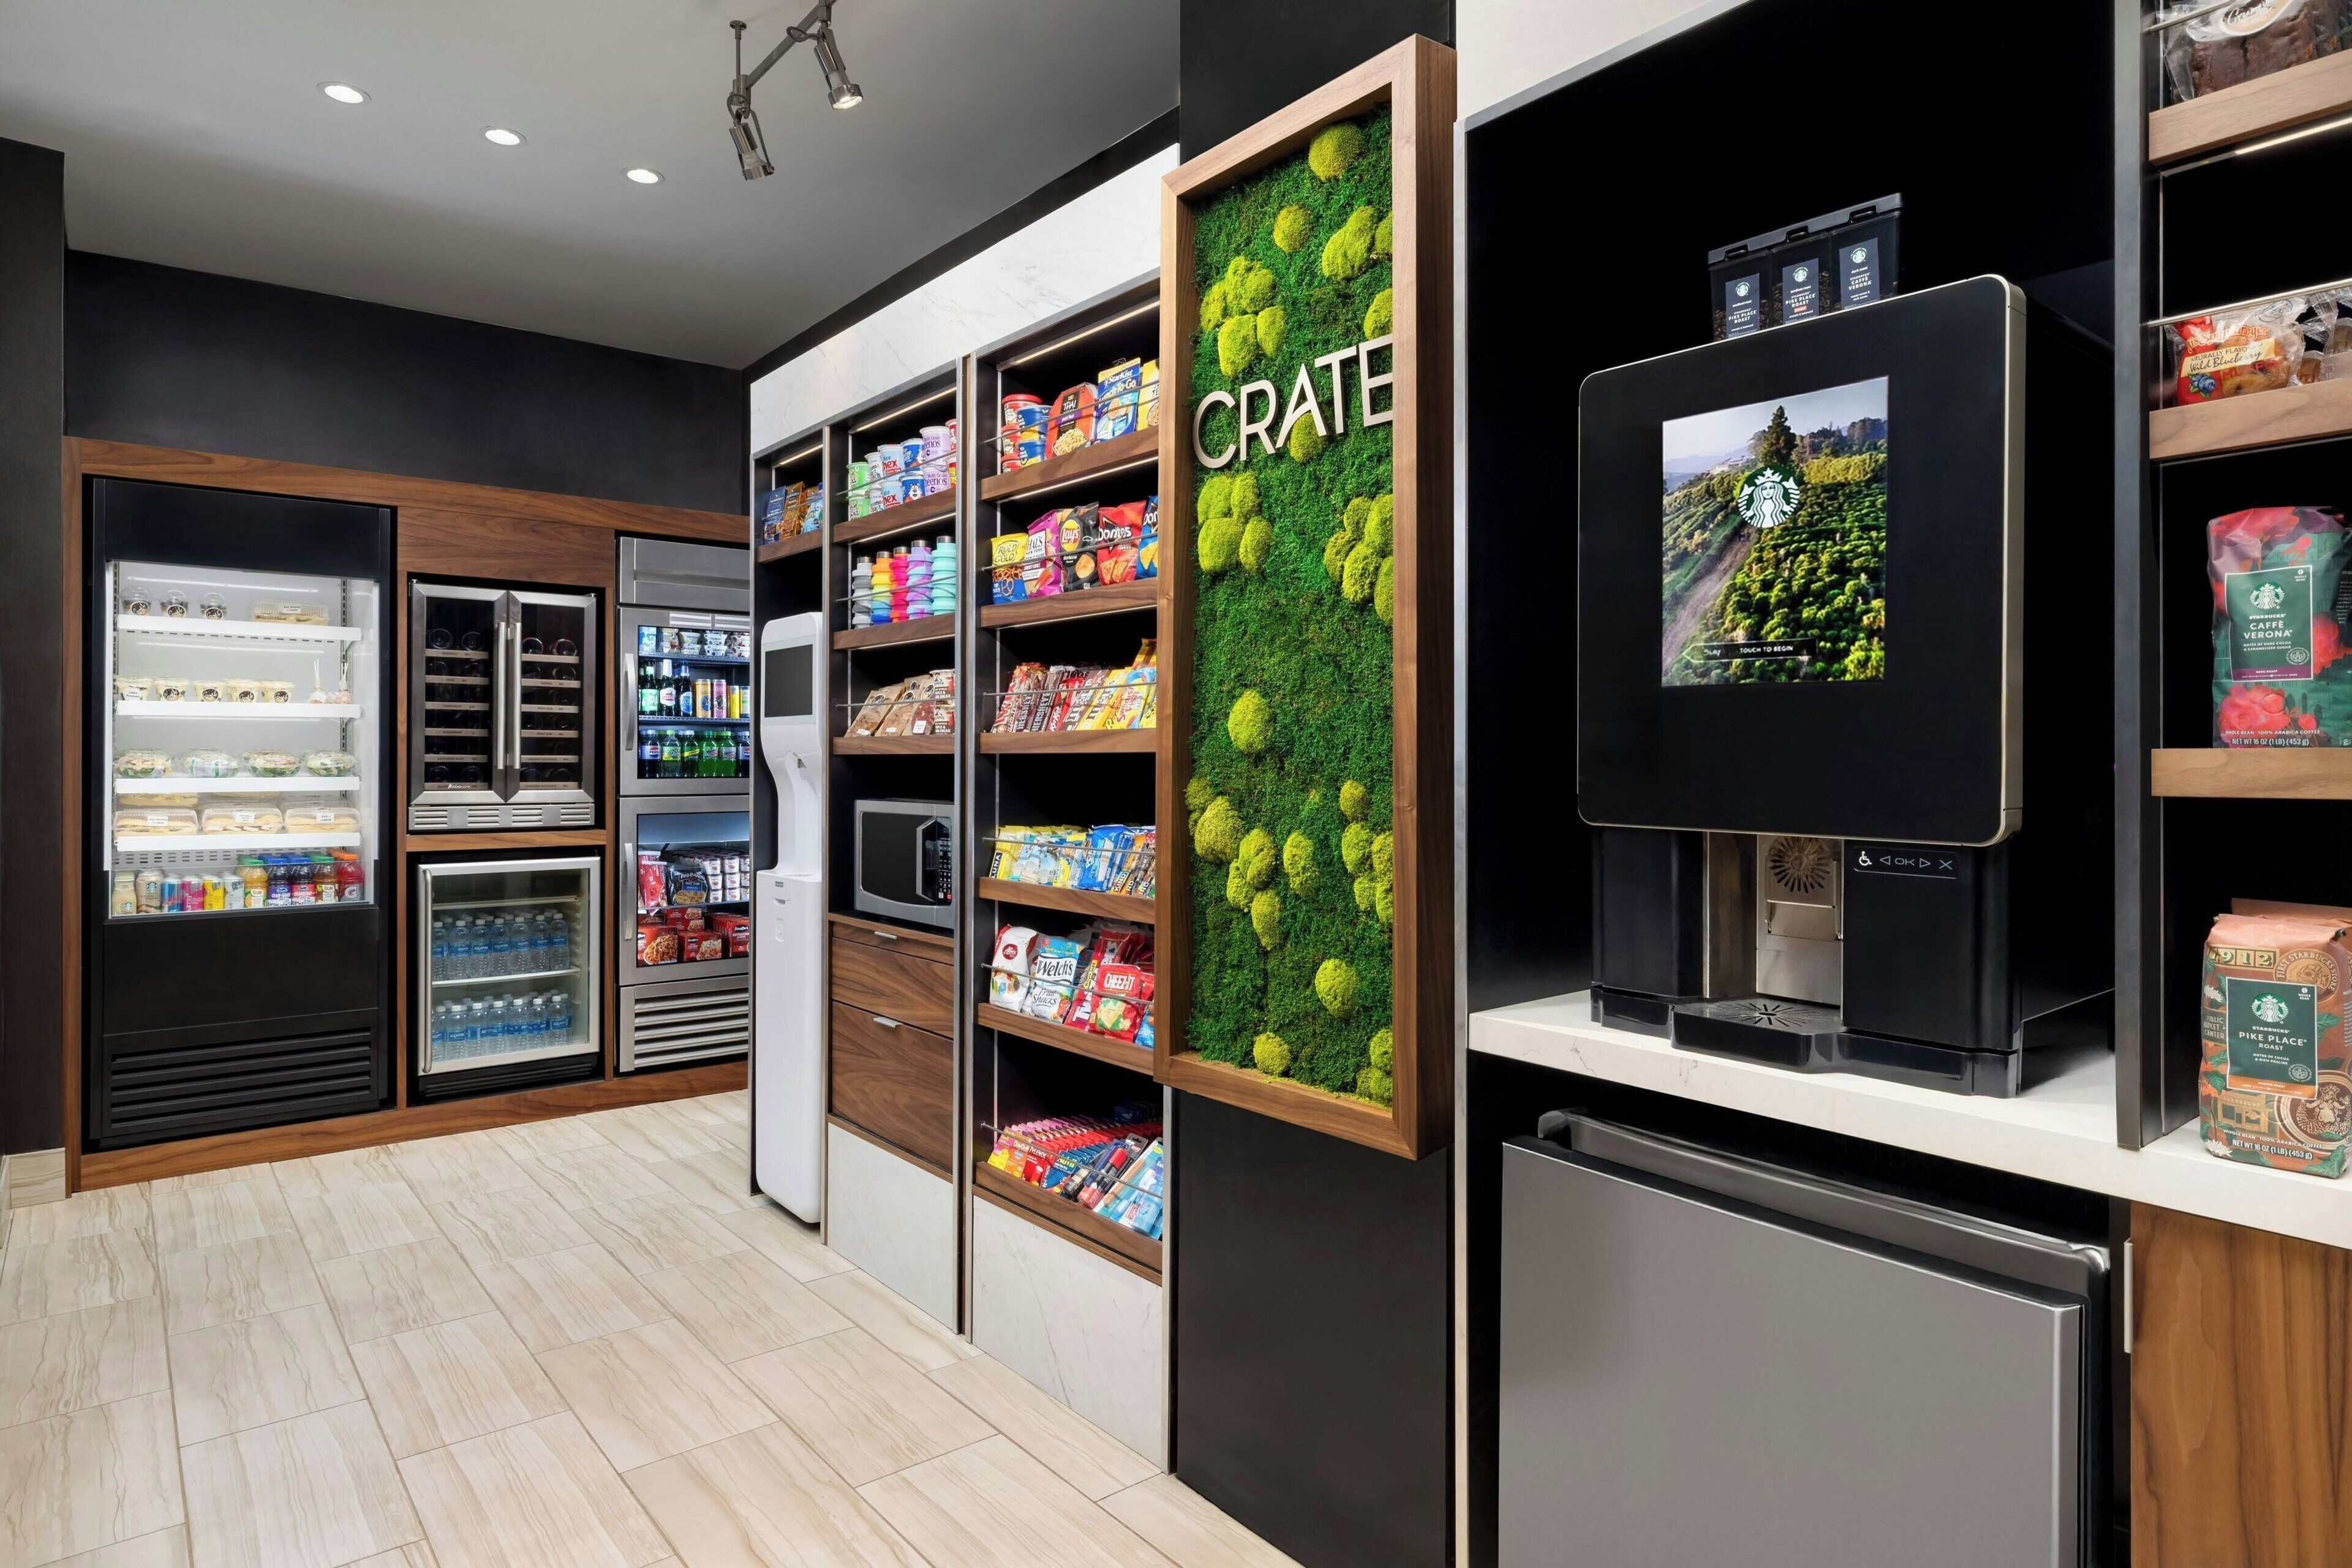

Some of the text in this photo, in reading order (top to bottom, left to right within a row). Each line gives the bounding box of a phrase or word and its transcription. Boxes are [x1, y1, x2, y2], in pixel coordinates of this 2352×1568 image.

[1849, 281, 1872, 290] VERONA
[2190, 361, 2212, 372] Wild
[1063, 400, 1077, 410] THAI
[1193, 334, 1393, 468] CRATE
[883, 459, 898, 470] hex
[883, 494, 897, 505] hex
[1062, 528, 1079, 545] Lay's
[1098, 526, 1132, 541] Doritos
[998, 543, 1017, 554] ROLD
[995, 554, 1014, 563] GOLD
[2250, 620, 2284, 630] CAFFÈ
[2244, 630, 2291, 639] VERONA
[991, 855, 1001, 878] LUNA
[1895, 858, 1915, 866] OK
[1114, 873, 1126, 892] KIND
[1139, 881, 1150, 895] IND
[1036, 959, 1073, 977] Welch's
[2277, 951, 2338, 991] FIRST STARBUCKS STORE
[1104, 973, 1135, 991] CHEEZ-IT
[1033, 994, 1057, 1005] Snacks
[2205, 1029, 2225, 1039] CENTER
[2239, 1031, 2304, 1046] PIKE PLACE
[1030, 1147, 1047, 1159] TYLENOL
[2277, 1147, 2288, 1156] LB)
[2289, 1149, 2304, 1158] (453
